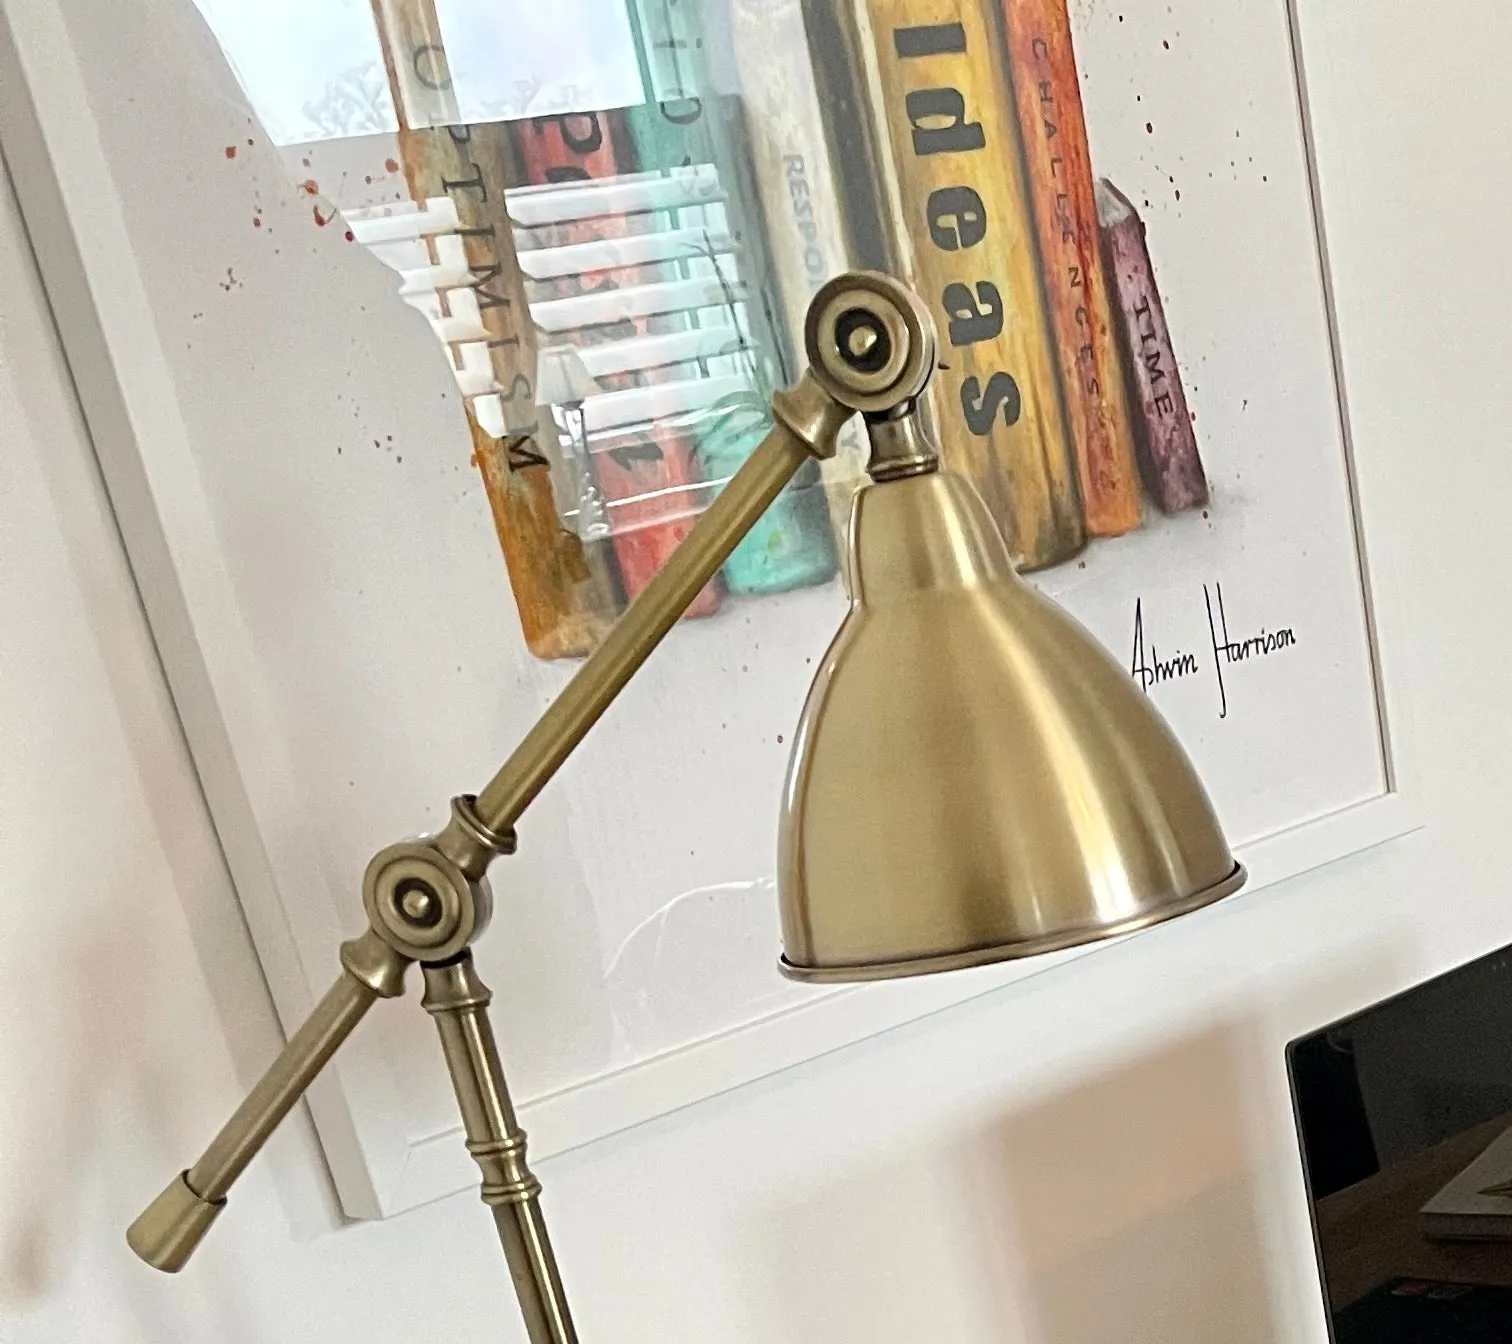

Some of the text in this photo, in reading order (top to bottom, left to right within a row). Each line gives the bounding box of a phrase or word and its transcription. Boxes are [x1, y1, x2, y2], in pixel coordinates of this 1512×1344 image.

[893, 22, 1021, 436] Ideas
[1132, 295, 1176, 419] TIME
[1203, 580, 1297, 720] Harrison
